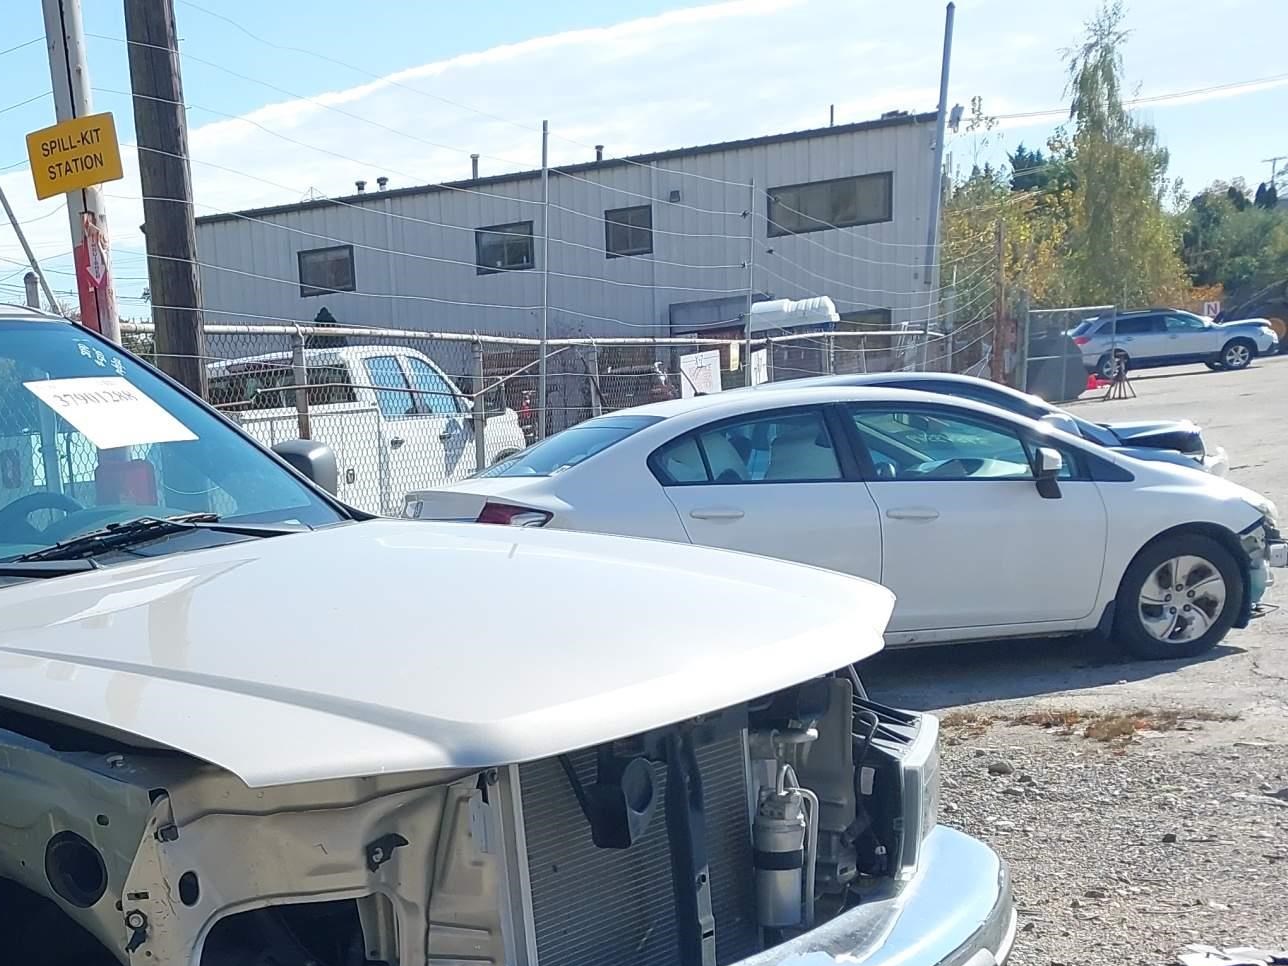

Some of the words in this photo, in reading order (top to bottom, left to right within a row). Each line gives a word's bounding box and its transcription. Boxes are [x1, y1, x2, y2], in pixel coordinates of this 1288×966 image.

[41, 127, 101, 157] SPILL-KIT
[47, 152, 104, 180] STATION
[1207, 303, 1218, 315] N
